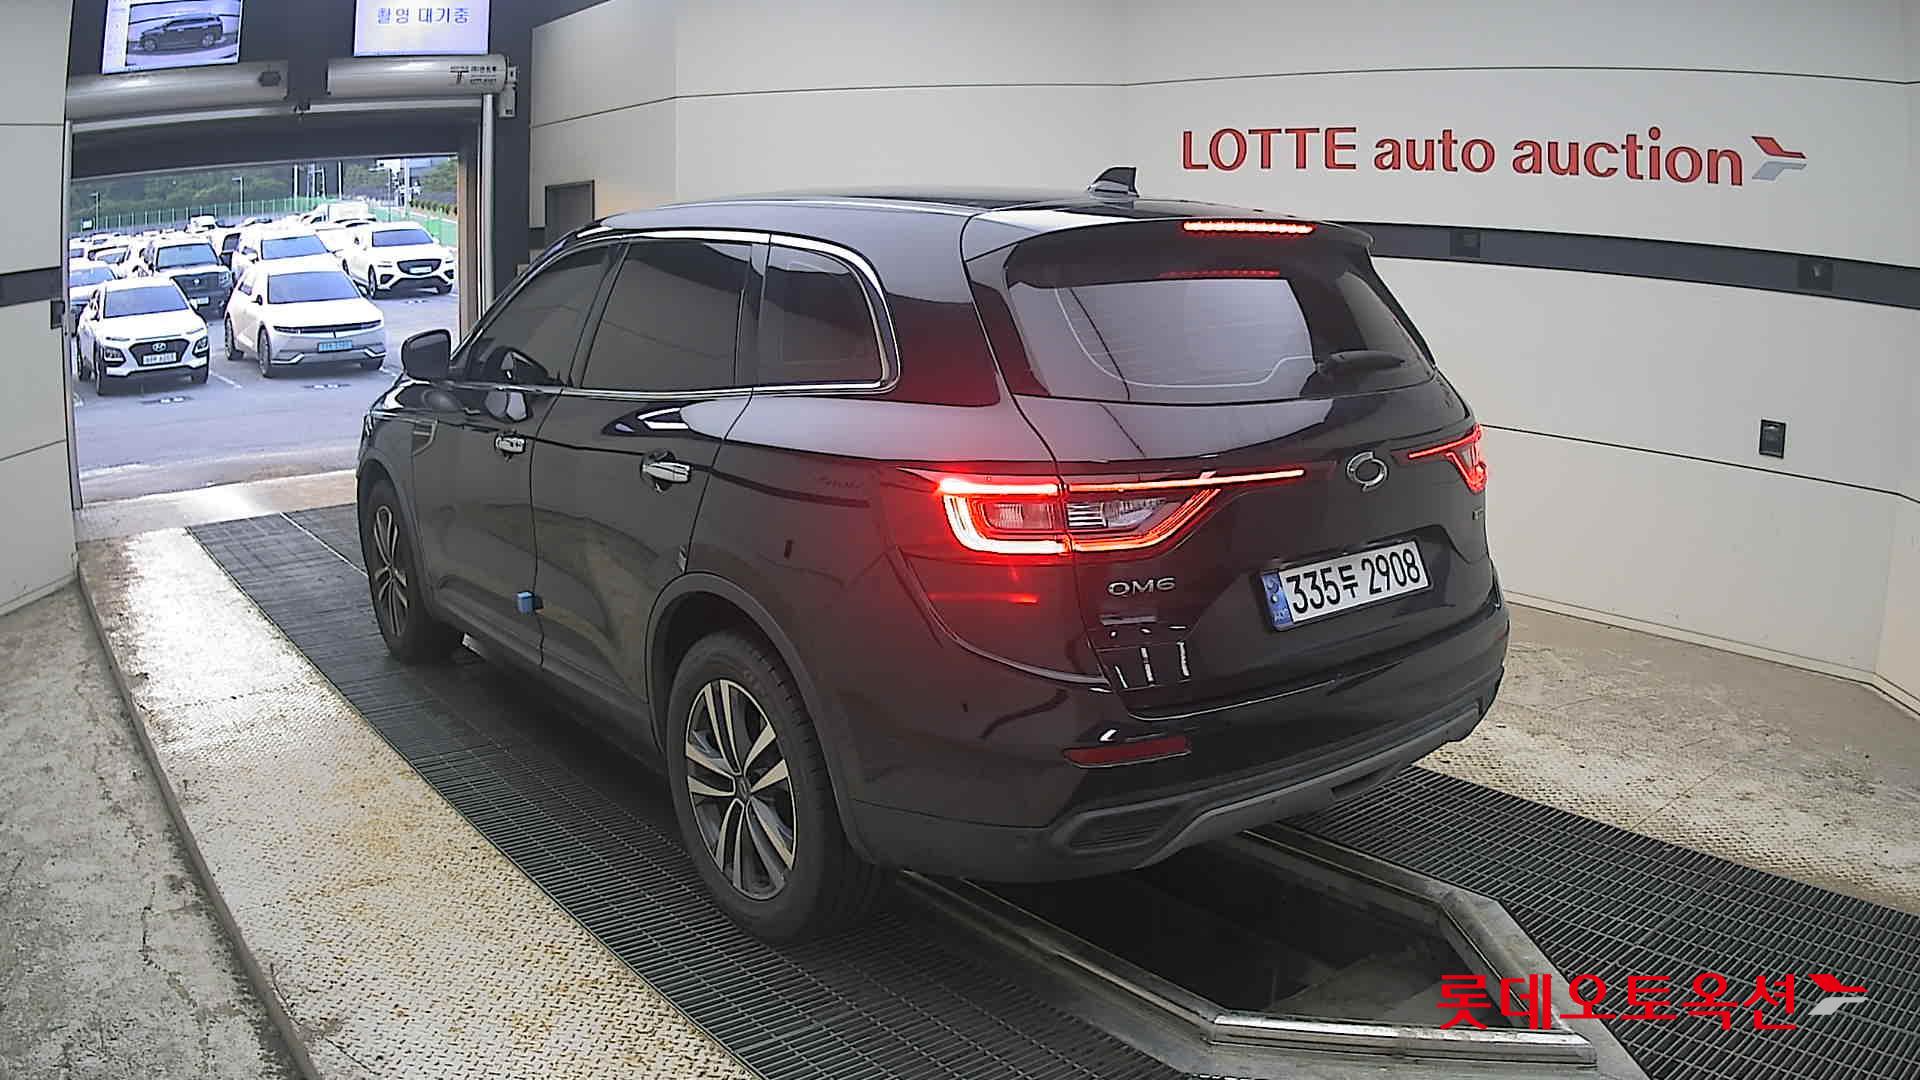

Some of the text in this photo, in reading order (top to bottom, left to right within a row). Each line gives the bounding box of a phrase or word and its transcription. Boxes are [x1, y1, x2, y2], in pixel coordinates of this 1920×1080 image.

[377, 7, 471, 24] 촬영 대기중
[1182, 126, 1743, 186] LOTTE auto auction
[1107, 577, 1176, 598] QM6
[1286, 548, 1421, 614] 335두 2908
